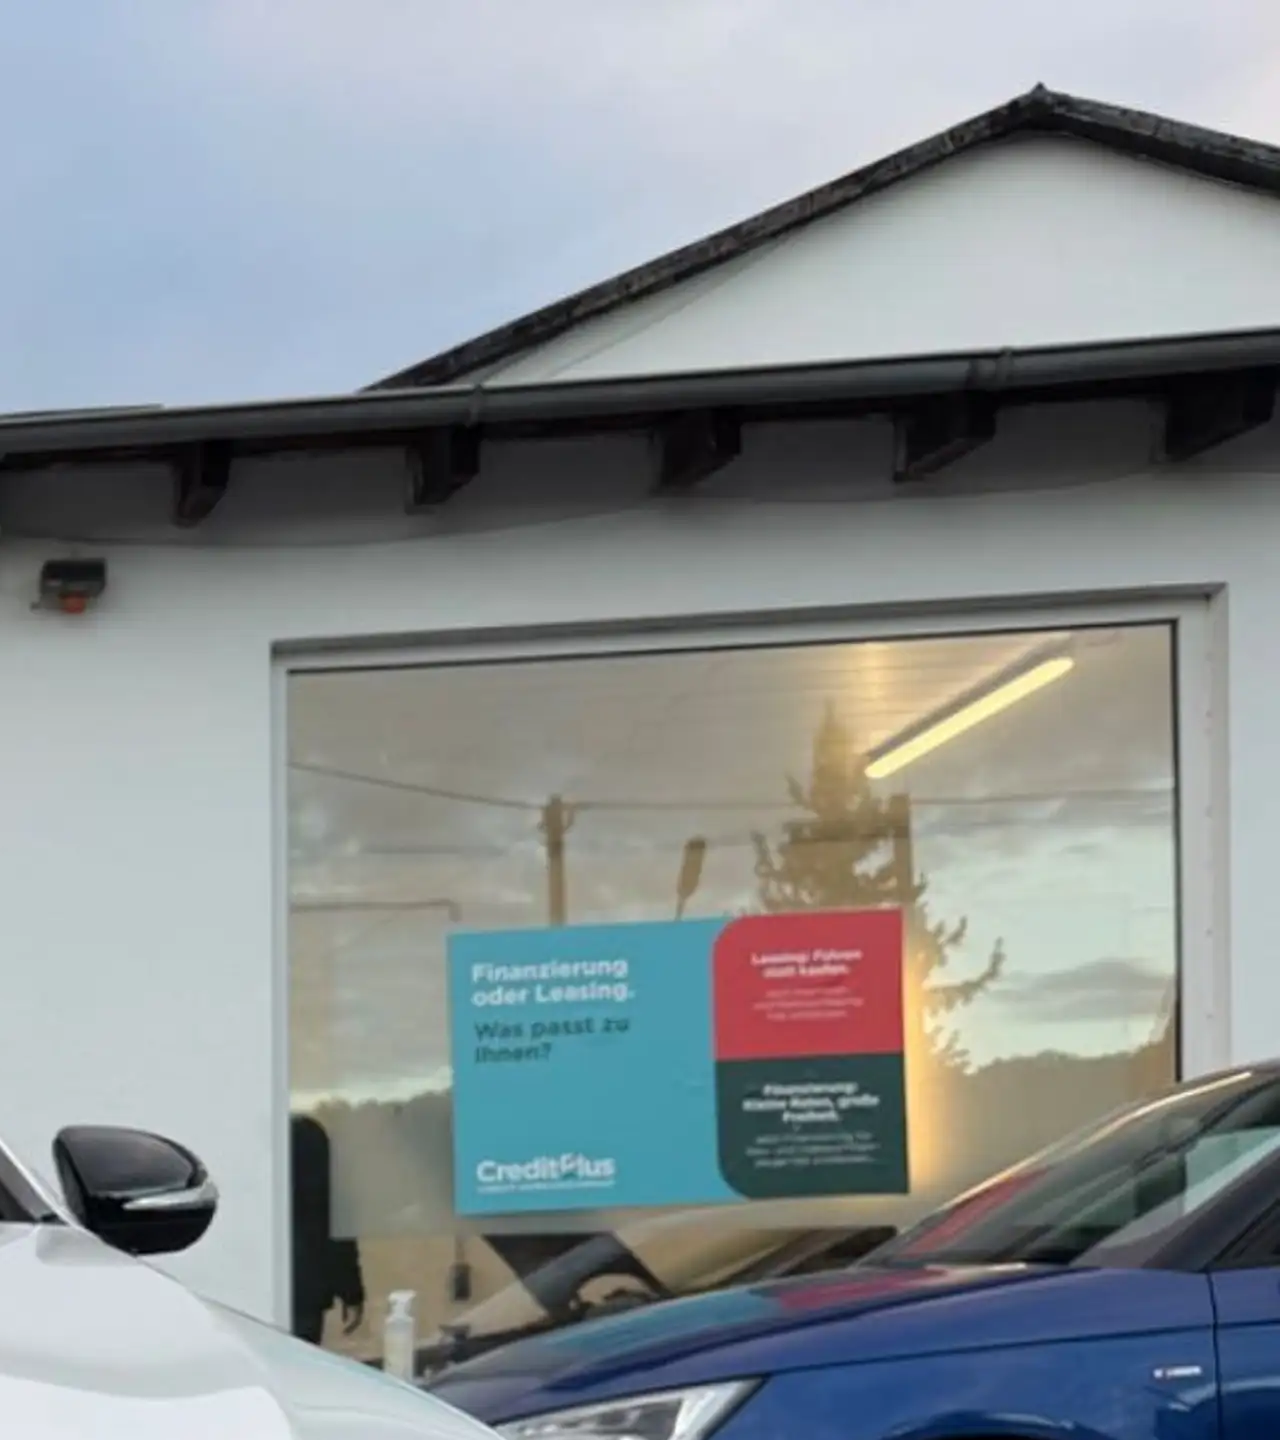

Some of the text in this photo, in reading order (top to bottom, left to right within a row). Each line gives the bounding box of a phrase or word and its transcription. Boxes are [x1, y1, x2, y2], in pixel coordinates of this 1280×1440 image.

[472, 959, 628, 982] Finanzierung
[471, 981, 636, 1006] oder Leasing.
[475, 1016, 630, 1041] Was passt zu
[475, 1042, 552, 1063] Ihnen?
[477, 1153, 617, 1182] CreditPlus
